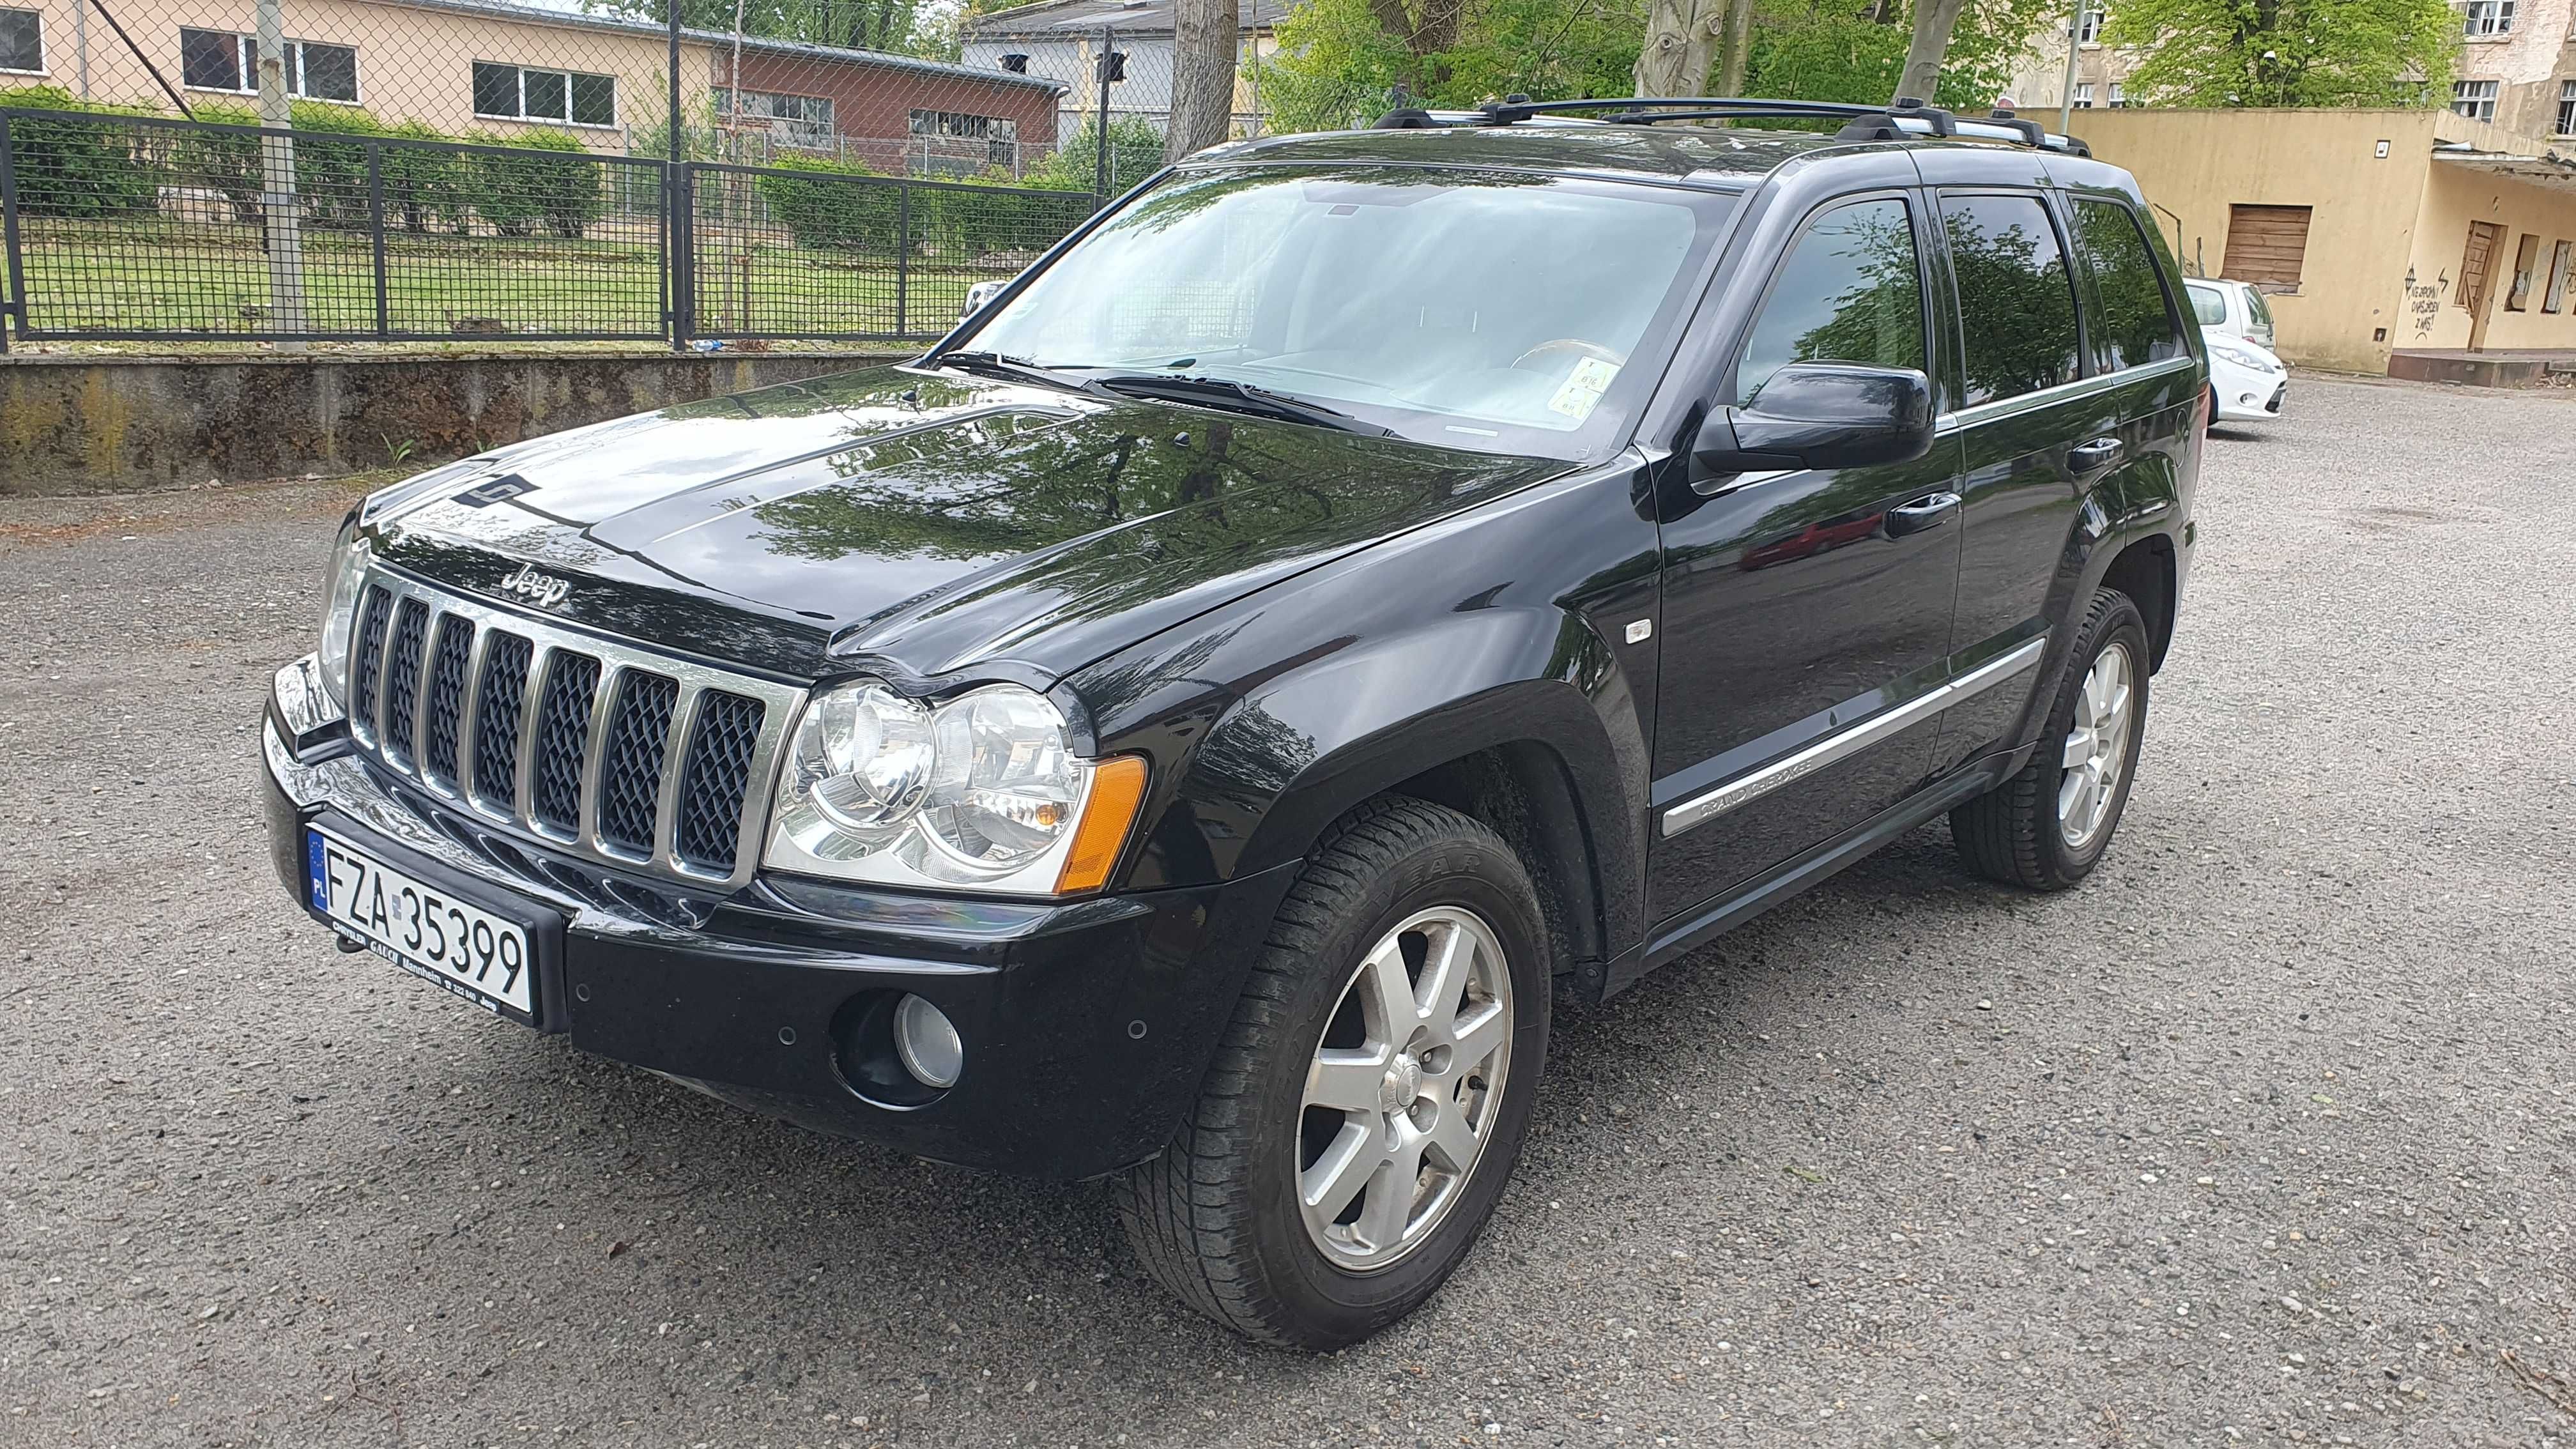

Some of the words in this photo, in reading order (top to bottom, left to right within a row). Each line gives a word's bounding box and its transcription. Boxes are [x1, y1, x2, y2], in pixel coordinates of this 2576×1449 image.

[501, 562, 571, 607] Jeep
[1700, 788, 1747, 817] GRAND
[1751, 759, 1813, 795] CHEROKEE
[313, 877, 326, 898] PL
[326, 847, 390, 939] FZA
[402, 887, 522, 994] 35399
[332, 921, 367, 946] CHRYSLER
[402, 957, 441, 985] Mannheim
